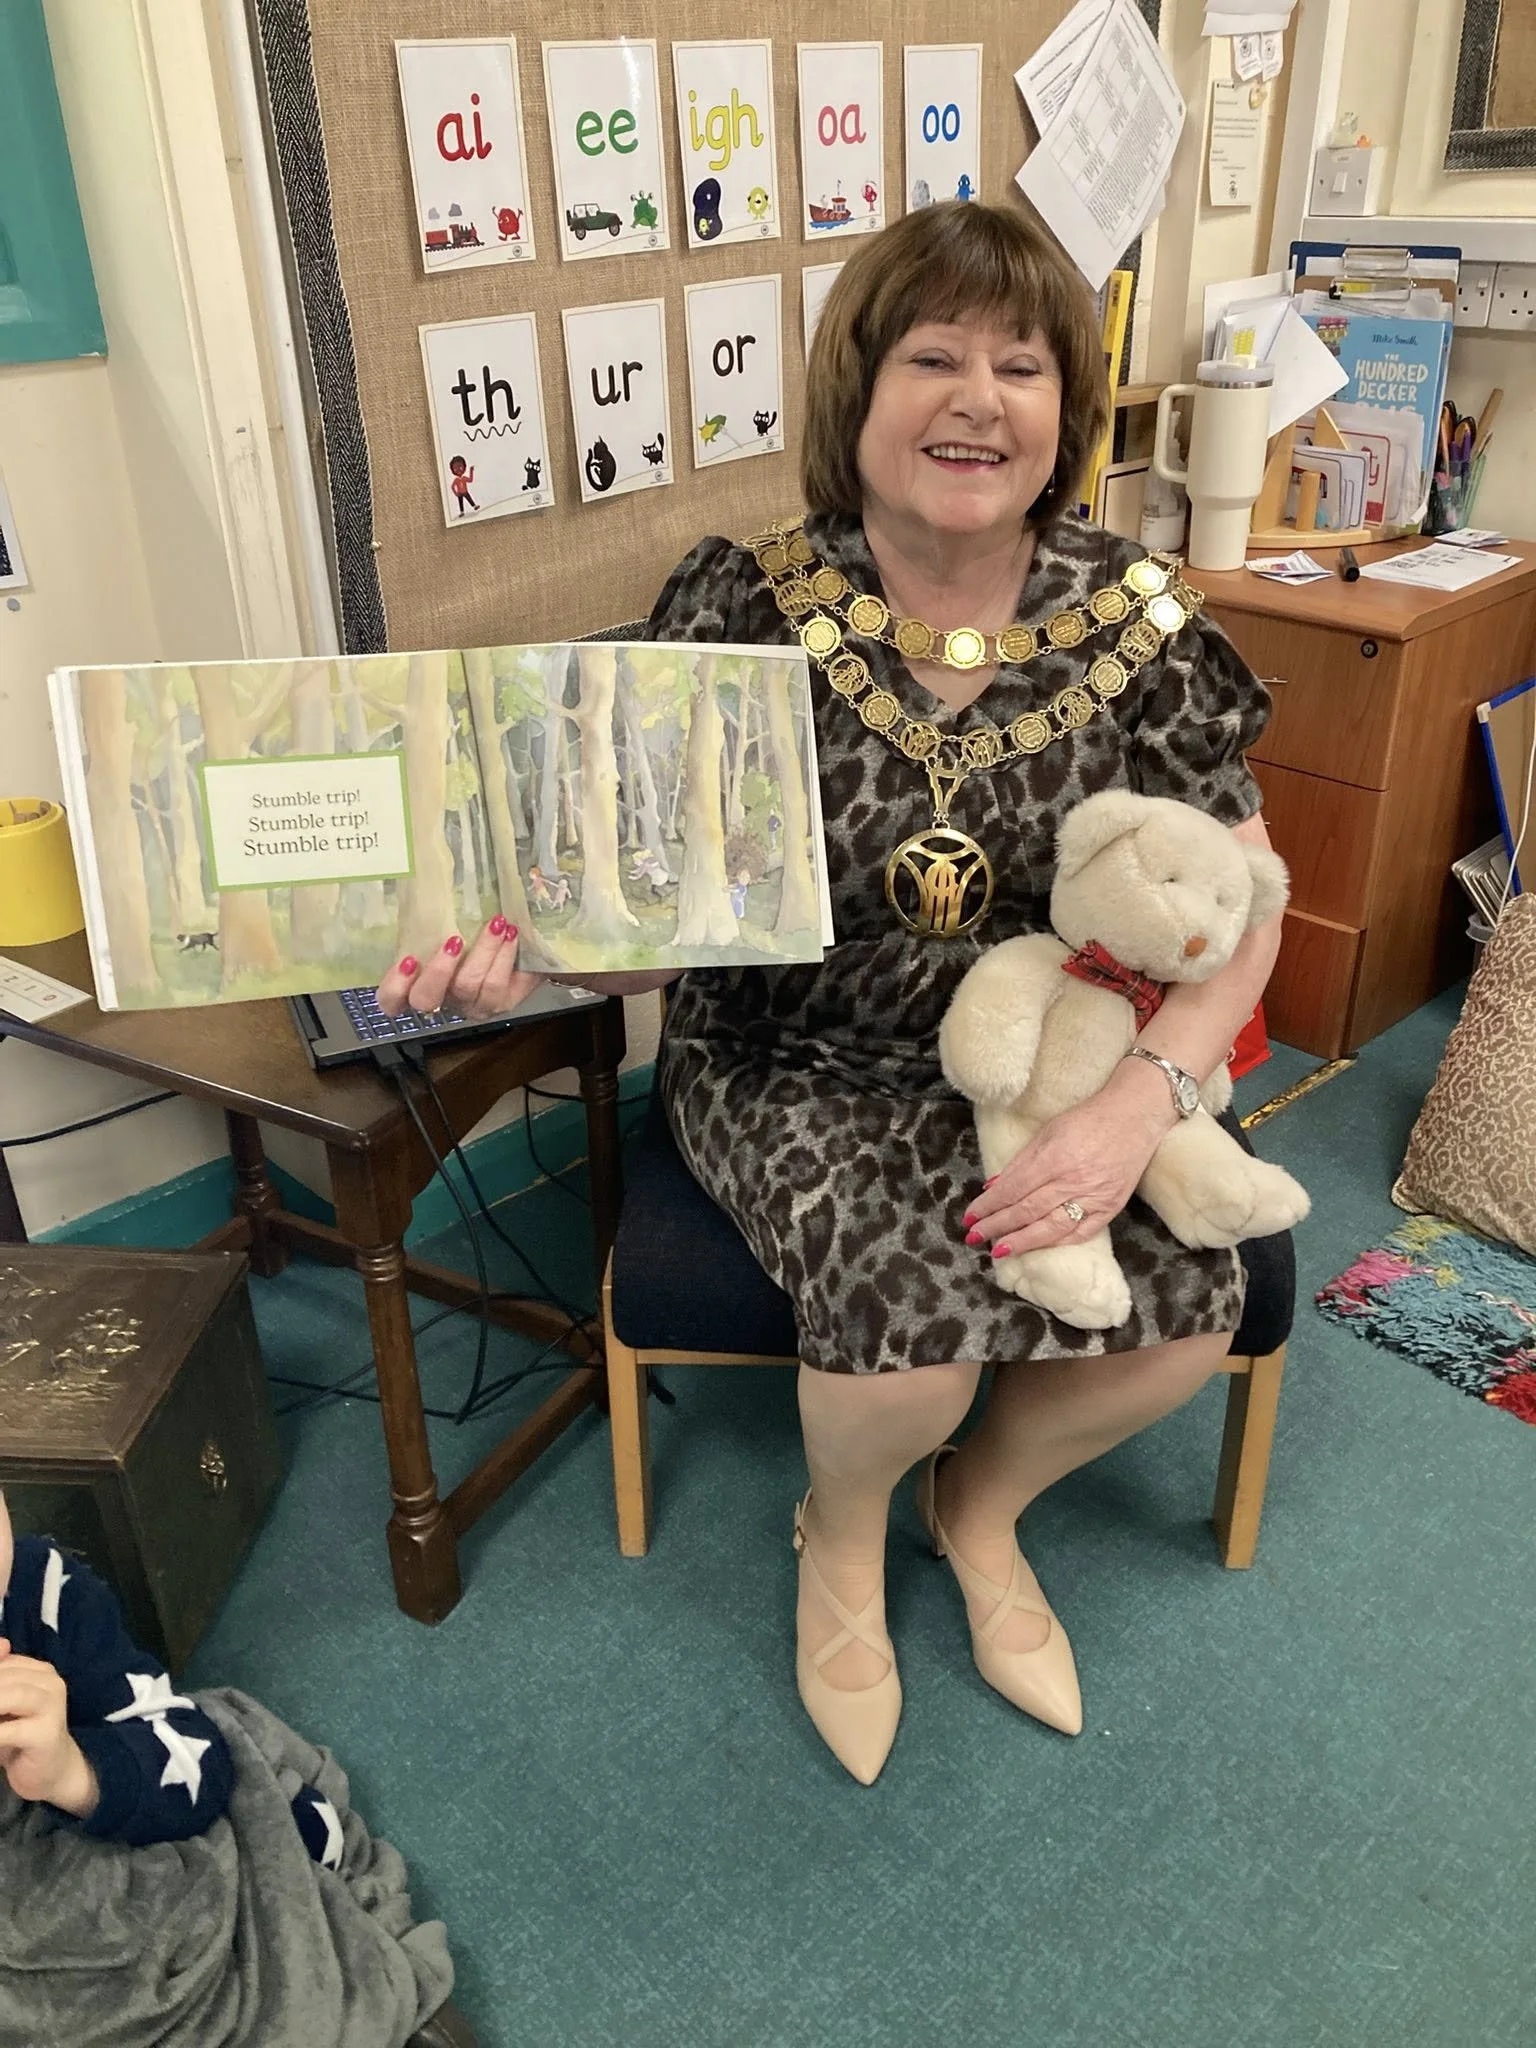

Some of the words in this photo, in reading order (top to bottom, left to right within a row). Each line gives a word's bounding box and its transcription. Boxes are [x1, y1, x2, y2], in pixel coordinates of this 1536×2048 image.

[437, 93, 492, 161] ai
[576, 109, 639, 156] ee
[688, 88, 764, 170] igh
[818, 104, 866, 146] oa
[922, 103, 960, 143] oo
[712, 334, 756, 377] or
[1372, 334, 1392, 344] Mike
[1384, 353, 1400, 361] THE
[591, 360, 643, 406] ur
[1354, 359, 1429, 383] HUNDRED
[451, 365, 521, 426] th
[1358, 381, 1418, 402] DECKER
[252, 791, 321, 809] Stumble
[326, 789, 361, 806] trip!
[248, 813, 325, 833] Stumble
[331, 811, 369, 829] trip!
[243, 835, 329, 857] Stumble
[336, 832, 379, 853] trip!
